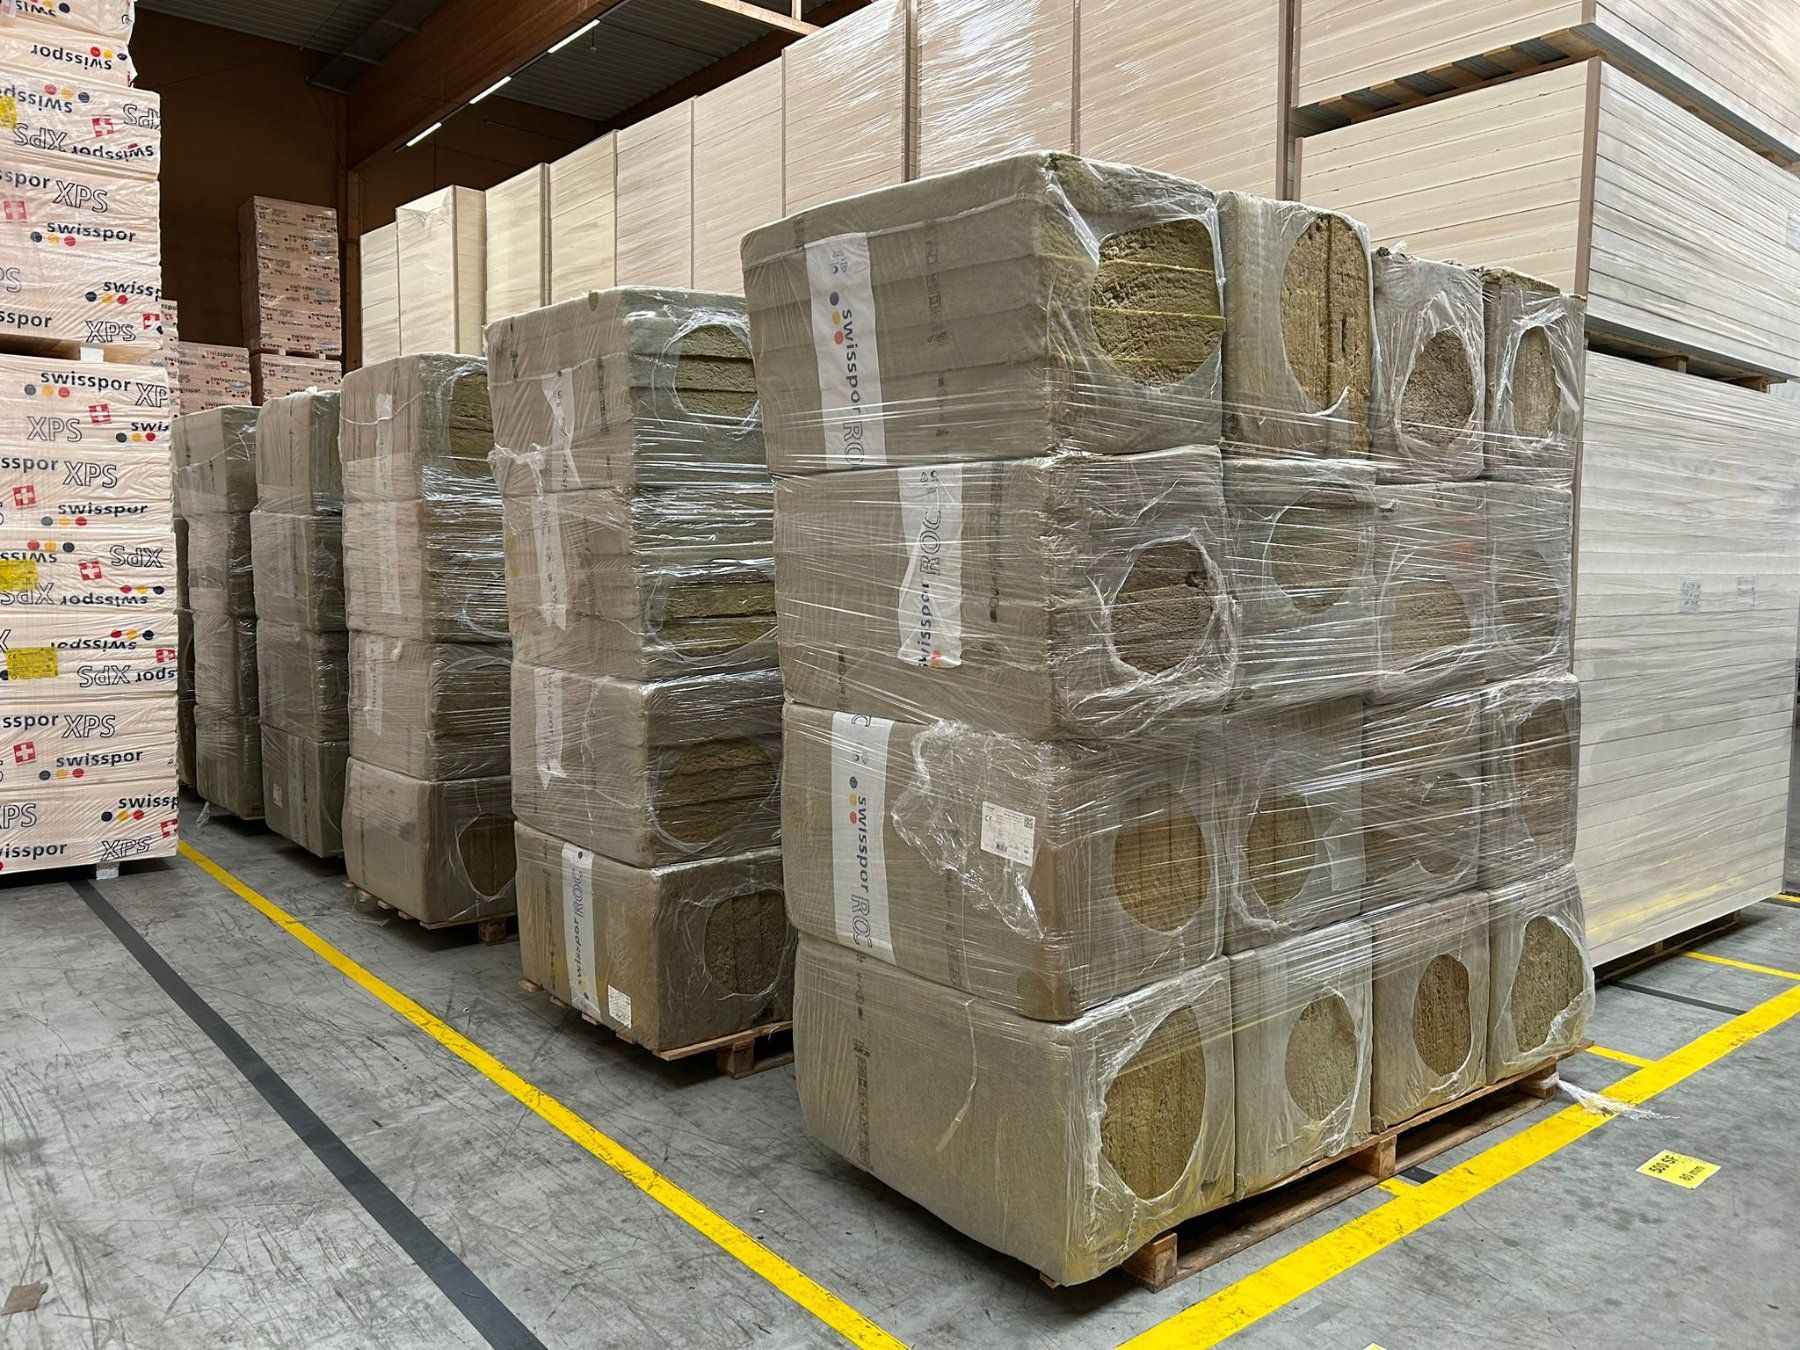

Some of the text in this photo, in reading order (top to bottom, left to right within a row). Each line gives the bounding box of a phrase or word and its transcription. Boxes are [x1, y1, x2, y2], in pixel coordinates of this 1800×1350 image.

[31, 45, 113, 70] swisspor
[0, 84, 73, 114] swissp
[13, 122, 155, 162] swisspor XPS
[52, 180, 109, 214] XPS
[47, 222, 137, 242] swisspor
[85, 319, 137, 344] XPS
[842, 308, 862, 414] swisspor
[40, 371, 132, 392] swisspor
[27, 415, 83, 443] XPS
[62, 460, 119, 488] XPS
[58, 502, 149, 518] swisspor
[110, 545, 165, 569] XPS
[60, 592, 149, 608] swisspor
[77, 665, 132, 688] XPS
[3, 714, 116, 739] sspor XPS
[56, 751, 144, 767] swisspor
[0, 803, 37, 830] PS
[100, 836, 152, 862] XPS
[856, 794, 870, 893] swisspor
